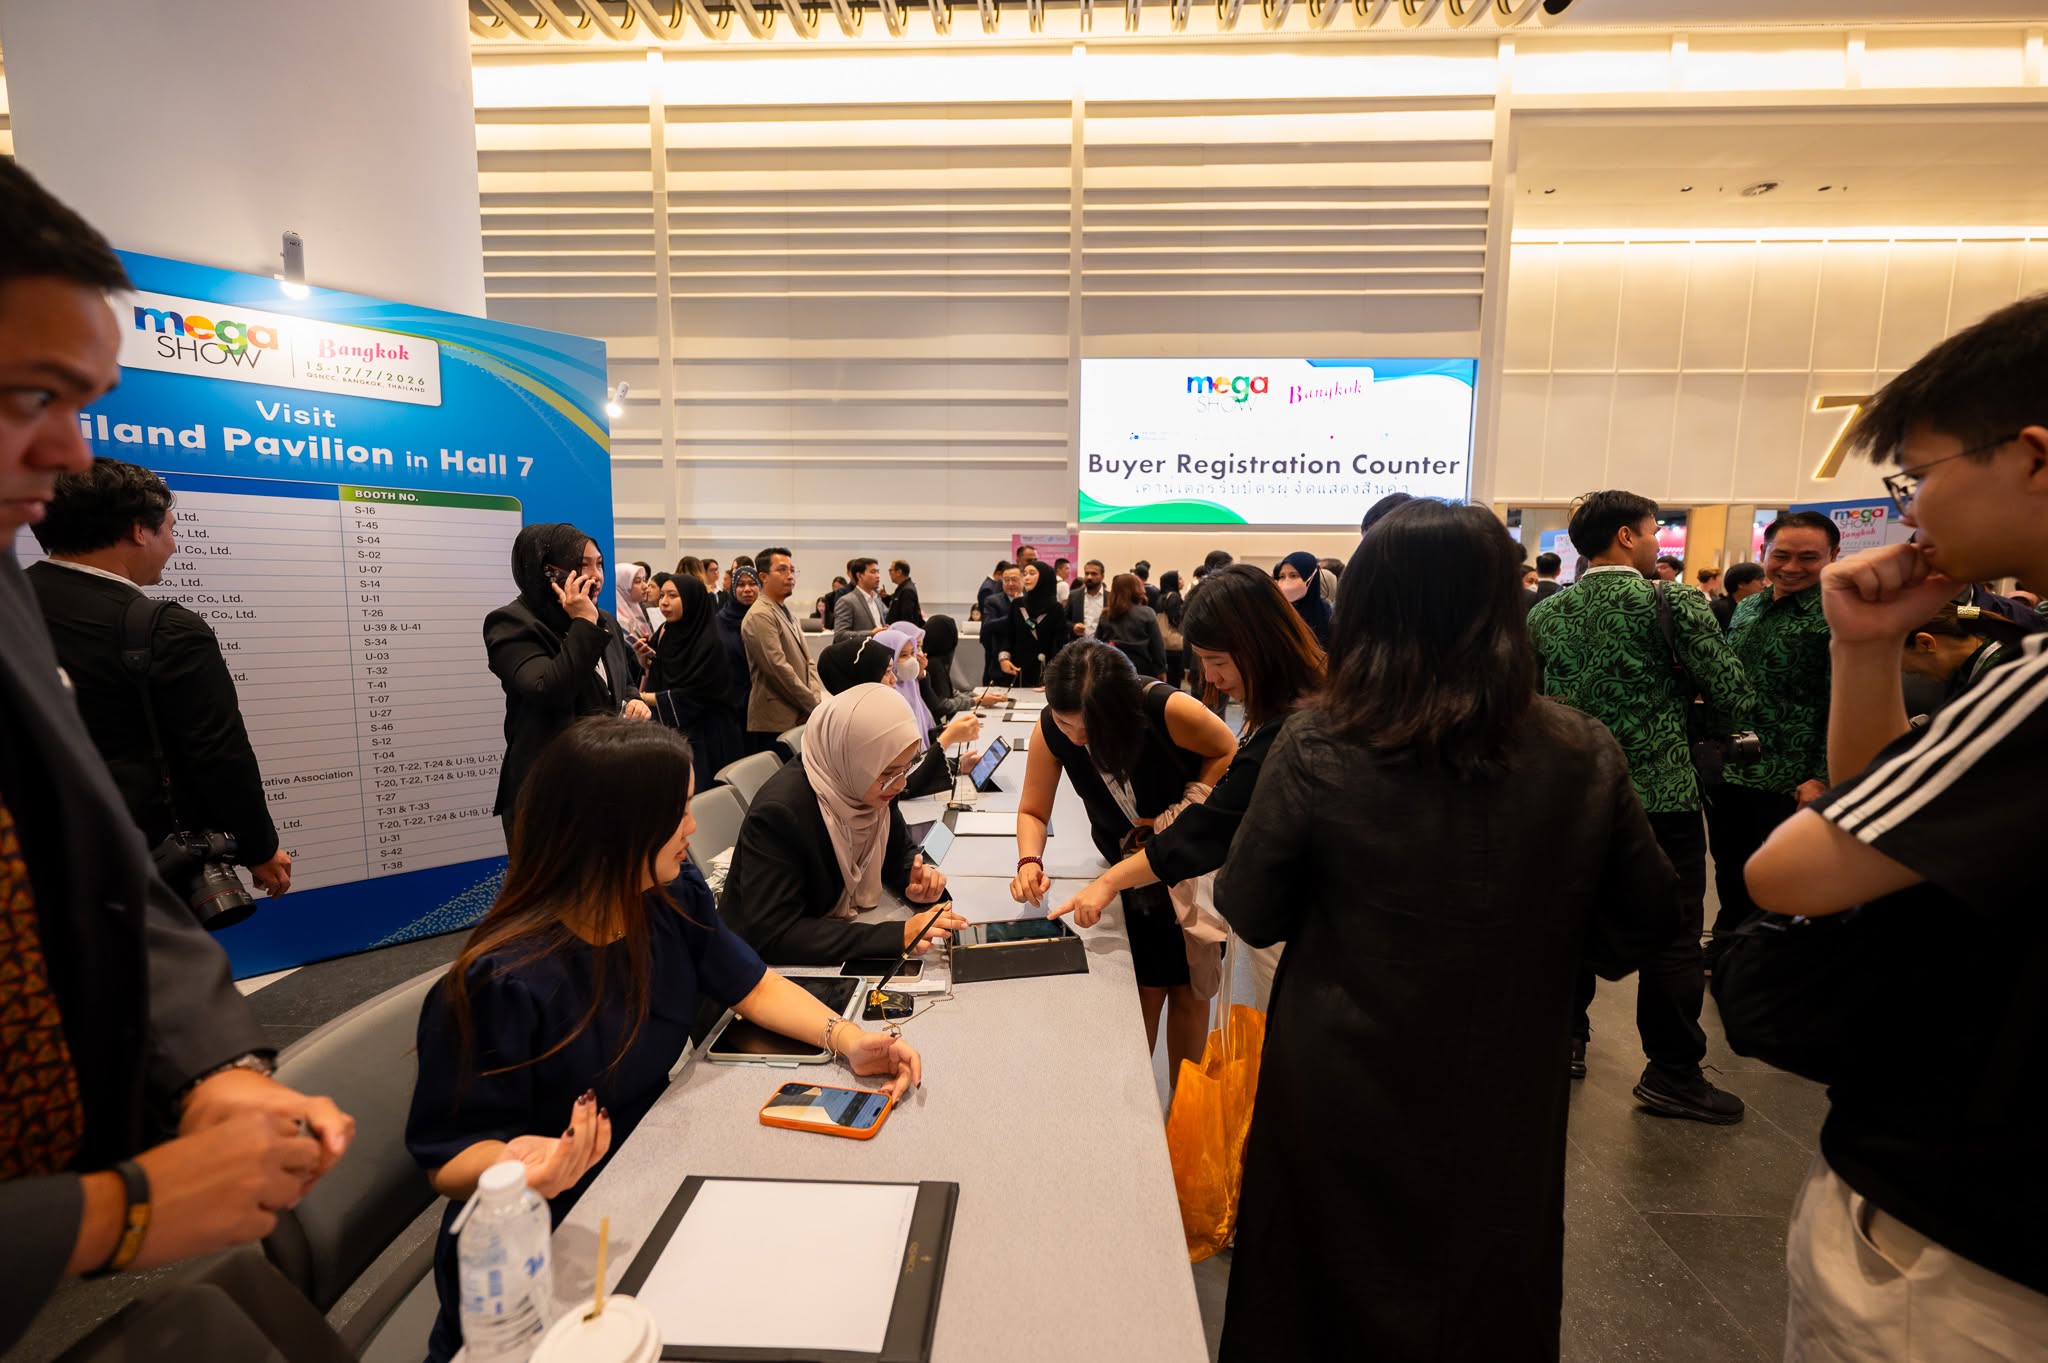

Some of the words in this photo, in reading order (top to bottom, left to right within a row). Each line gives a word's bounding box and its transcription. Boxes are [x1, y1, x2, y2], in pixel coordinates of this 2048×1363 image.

[133, 306, 279, 355] mega
[157, 335, 262, 368] SHOW
[319, 338, 410, 363] Bangkok
[306, 372, 339, 382] QSNCC,
[342, 377, 385, 388] BANGKOK,
[388, 383, 425, 393] THAILAND
[1187, 376, 1269, 403] mega
[1289, 380, 1362, 404] Bangkok
[1197, 395, 1258, 413] SHOW
[255, 400, 337, 428] Visit
[1814, 394, 1877, 479] 7
[80, 413, 206, 449] iland
[223, 427, 394, 466] Pavilion
[405, 451, 428, 469] in
[440, 448, 507, 475] Hall
[516, 456, 534, 477] 7
[1088, 453, 1166, 480] Buyer
[1177, 452, 1341, 480] Registration
[1352, 453, 1461, 475] Counter
[355, 490, 396, 500] BOOTH
[398, 493, 419, 502] NO.
[355, 505, 376, 515] S-16
[177, 512, 200, 521] Ltd.
[1834, 508, 1884, 523] mega
[356, 521, 379, 530] T-45
[1839, 518, 1876, 529] SHOW
[171, 530, 184, 538] o.,
[187, 529, 210, 538] Ltd.
[1840, 528, 1876, 539] Bangkok
[357, 535, 380, 544] S-04
[184, 545, 207, 555] Co.,
[210, 546, 232, 555] Ltd.
[358, 550, 381, 559] S-02
[174, 562, 197, 570] Ltd.
[359, 565, 383, 574] U-07
[181, 578, 203, 587] Ltd.
[360, 580, 380, 588] S-14
[197, 594, 219, 603] Co.,
[222, 594, 243, 603] Ltd.
[361, 594, 380, 603] U-11
[211, 610, 233, 619] Co.,
[236, 610, 257, 618] Ltd.
[361, 609, 384, 617] T-26
[363, 624, 387, 632] U-39
[390, 623, 398, 632] &
[400, 623, 421, 631] U-41
[220, 641, 241, 650] Ltd.
[364, 638, 387, 646] S-34
[365, 652, 390, 661] U-03
[366, 667, 389, 675] T-32
[233, 673, 249, 681] td.
[367, 681, 387, 689] T-41
[368, 695, 390, 703] T-07
[369, 709, 392, 718] U-27
[370, 723, 394, 732] S-46
[371, 738, 392, 746] S-12
[373, 751, 395, 760] T-04
[374, 765, 397, 774] T-20,
[399, 762, 422, 772] T-22,
[424, 760, 443, 768] T-24
[446, 759, 453, 767] &
[455, 757, 476, 765] U-19,
[478, 754, 498, 763] U-21,
[293, 770, 354, 784] Association
[375, 779, 398, 788] T-20,
[400, 776, 423, 785] T-22,
[425, 773, 444, 782] T-24
[447, 772, 454, 780] &
[456, 769, 477, 778] U-19,
[479, 767, 499, 776] U-21,
[267, 792, 288, 801] Ltd.
[376, 793, 396, 802] T-27
[377, 807, 396, 816] T-31
[398, 805, 407, 813] &
[409, 803, 430, 812] T-33
[378, 820, 401, 830] T-20,
[404, 817, 426, 826] T-22,
[428, 814, 447, 823] T-24
[459, 809, 480, 818] U-19,
[283, 820, 303, 829] Ltd.
[380, 834, 400, 844] U-31
[286, 850, 300, 858] td.
[380, 848, 402, 857] S-42
[382, 861, 403, 871] T-38
